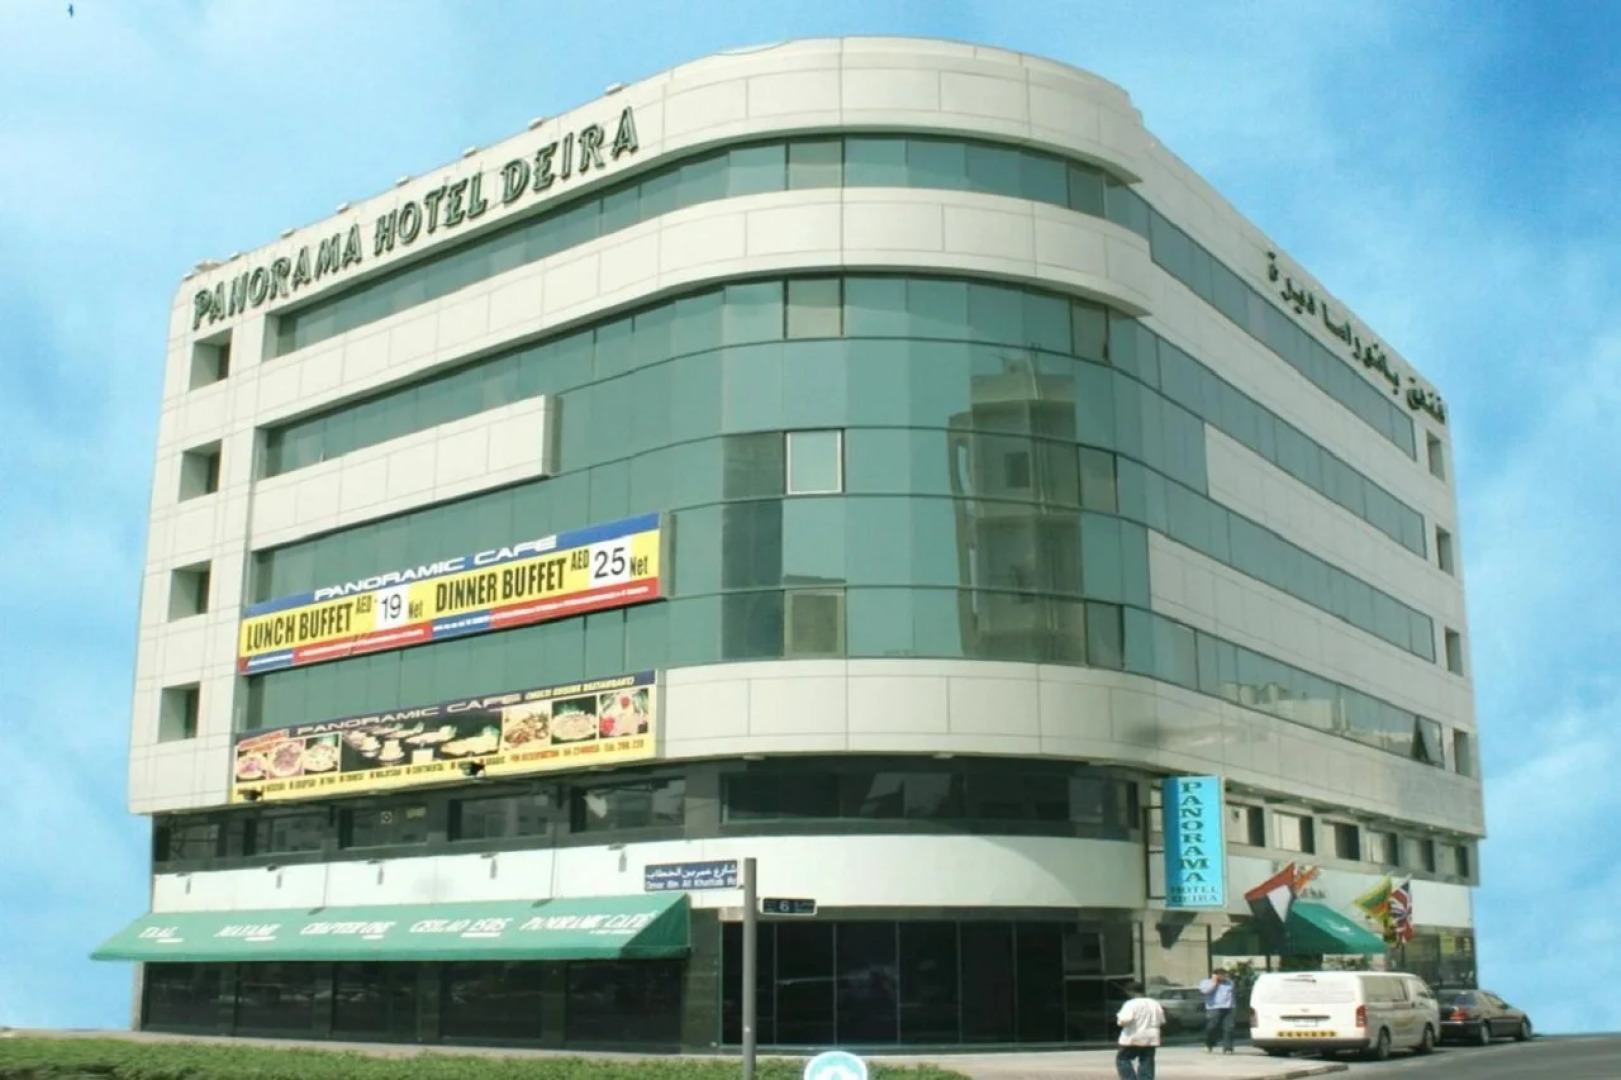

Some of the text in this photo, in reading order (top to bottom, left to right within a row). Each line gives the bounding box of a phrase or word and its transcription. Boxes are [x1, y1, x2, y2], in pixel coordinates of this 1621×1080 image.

[193, 106, 639, 329] PANORAMA HOTEL DEIRA
[1406, 376, 1446, 425] فندق
[246, 615, 296, 652] LUNCH
[299, 602, 353, 641] BUFFET
[381, 593, 402, 622] 19
[436, 573, 498, 612] DINNER
[502, 558, 568, 594] BUFFET
[570, 548, 590, 571] AED
[594, 546, 625, 580] 25
[630, 555, 648, 578] Net
[314, 534, 557, 601] PANORAMIC CAFE
[297, 706, 441, 736] PANORAMIC
[1180, 781, 1210, 882] PANORAMA
